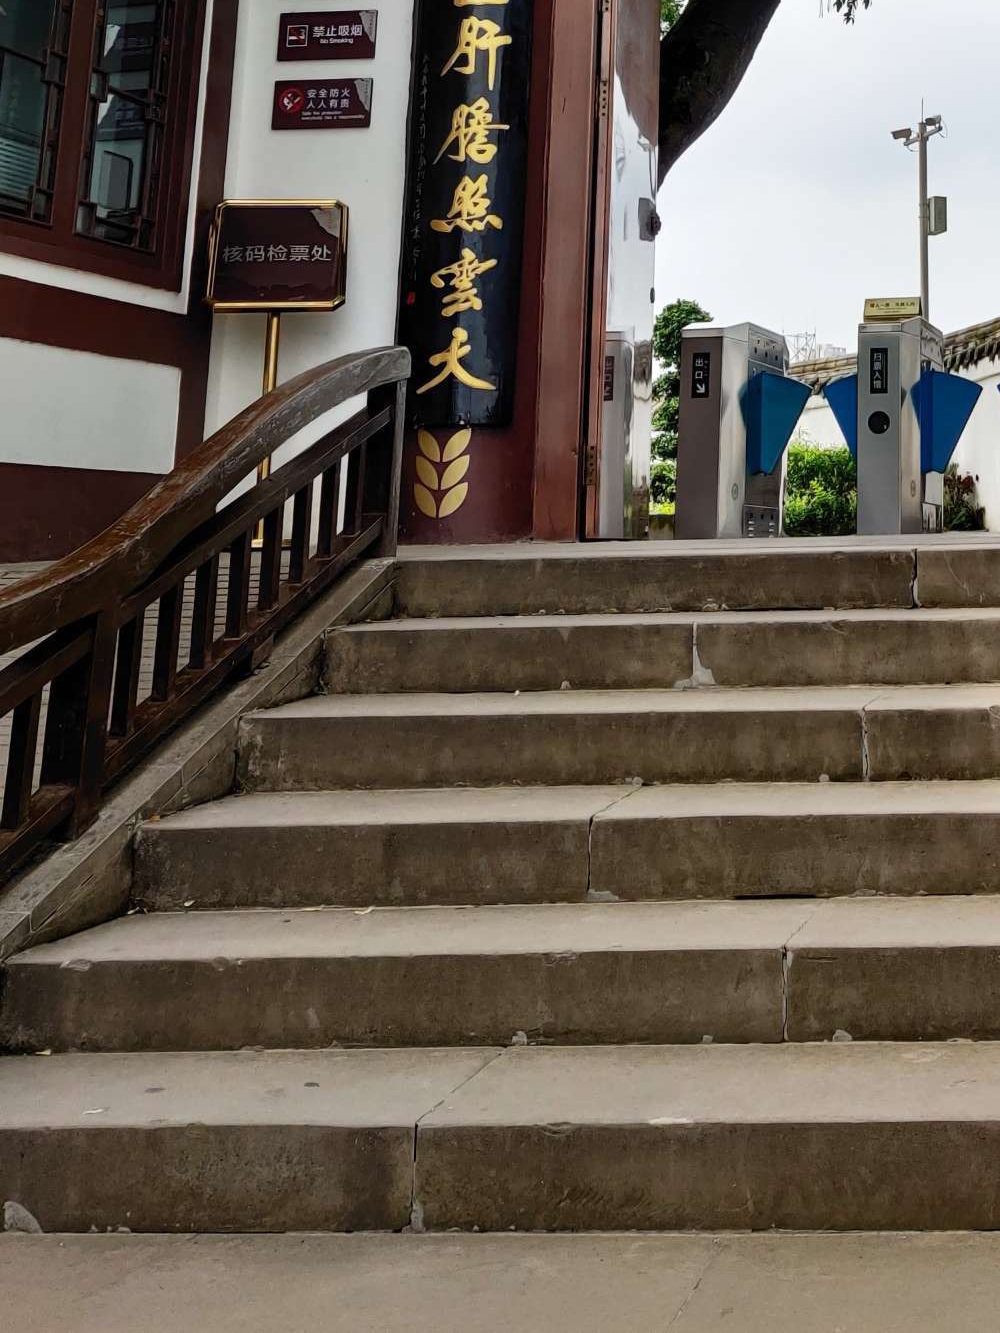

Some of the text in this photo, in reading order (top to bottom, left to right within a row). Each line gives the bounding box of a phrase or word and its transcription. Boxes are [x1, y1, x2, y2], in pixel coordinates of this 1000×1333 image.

[312, 24, 363, 38] 禁止吸烟
[306, 88, 351, 99] 安全防火
[306, 98, 349, 109] 人人有责
[222, 244, 332, 263] 核码检票处
[695, 358, 704, 379] 出口
